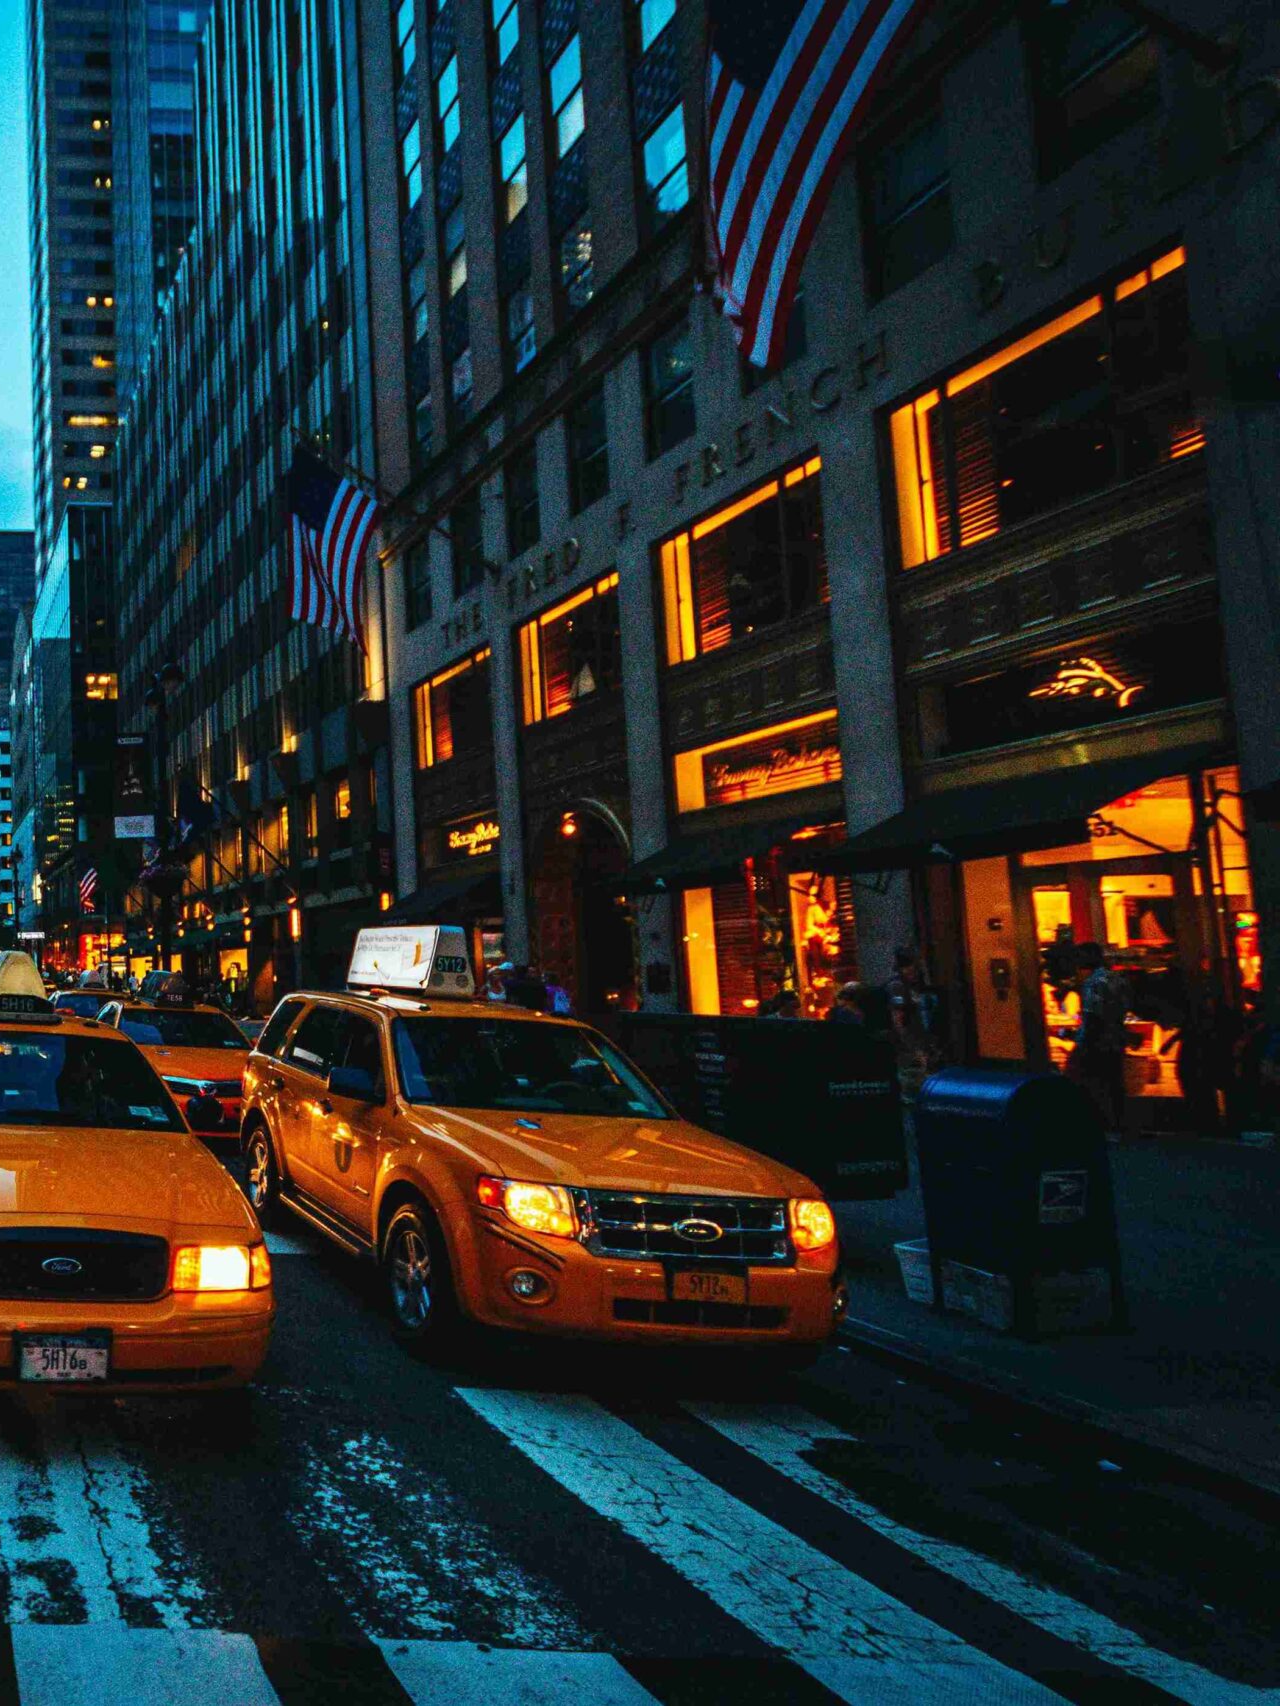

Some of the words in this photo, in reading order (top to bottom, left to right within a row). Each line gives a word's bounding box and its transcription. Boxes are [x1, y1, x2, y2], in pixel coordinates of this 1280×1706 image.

[441, 603, 482, 649] THE
[505, 537, 580, 610] FRED
[673, 330, 890, 504] FRENCH
[437, 957, 465, 972] 5Y12
[1, 998, 34, 1013] 5H16
[51, 1262, 72, 1272] Ford
[42, 1348, 87, 1371] 5H16B
